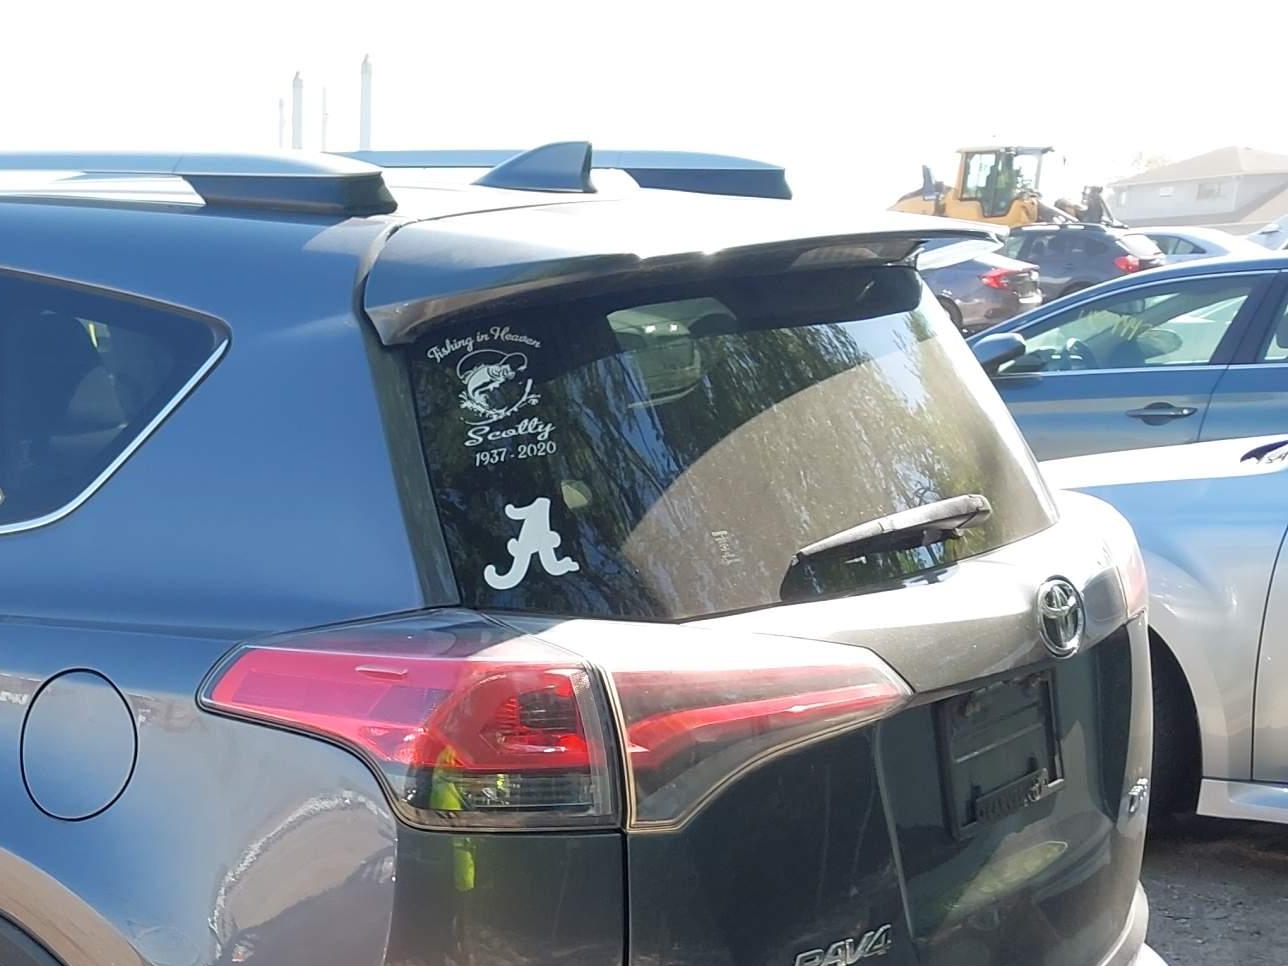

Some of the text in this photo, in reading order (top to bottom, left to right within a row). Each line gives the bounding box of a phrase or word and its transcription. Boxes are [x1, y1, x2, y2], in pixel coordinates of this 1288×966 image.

[426, 325, 541, 363] Fishing in Heaven
[464, 417, 557, 447] Scotty
[475, 447, 507, 467] 1937
[518, 440, 557, 459] 2020
[483, 497, 580, 590] A
